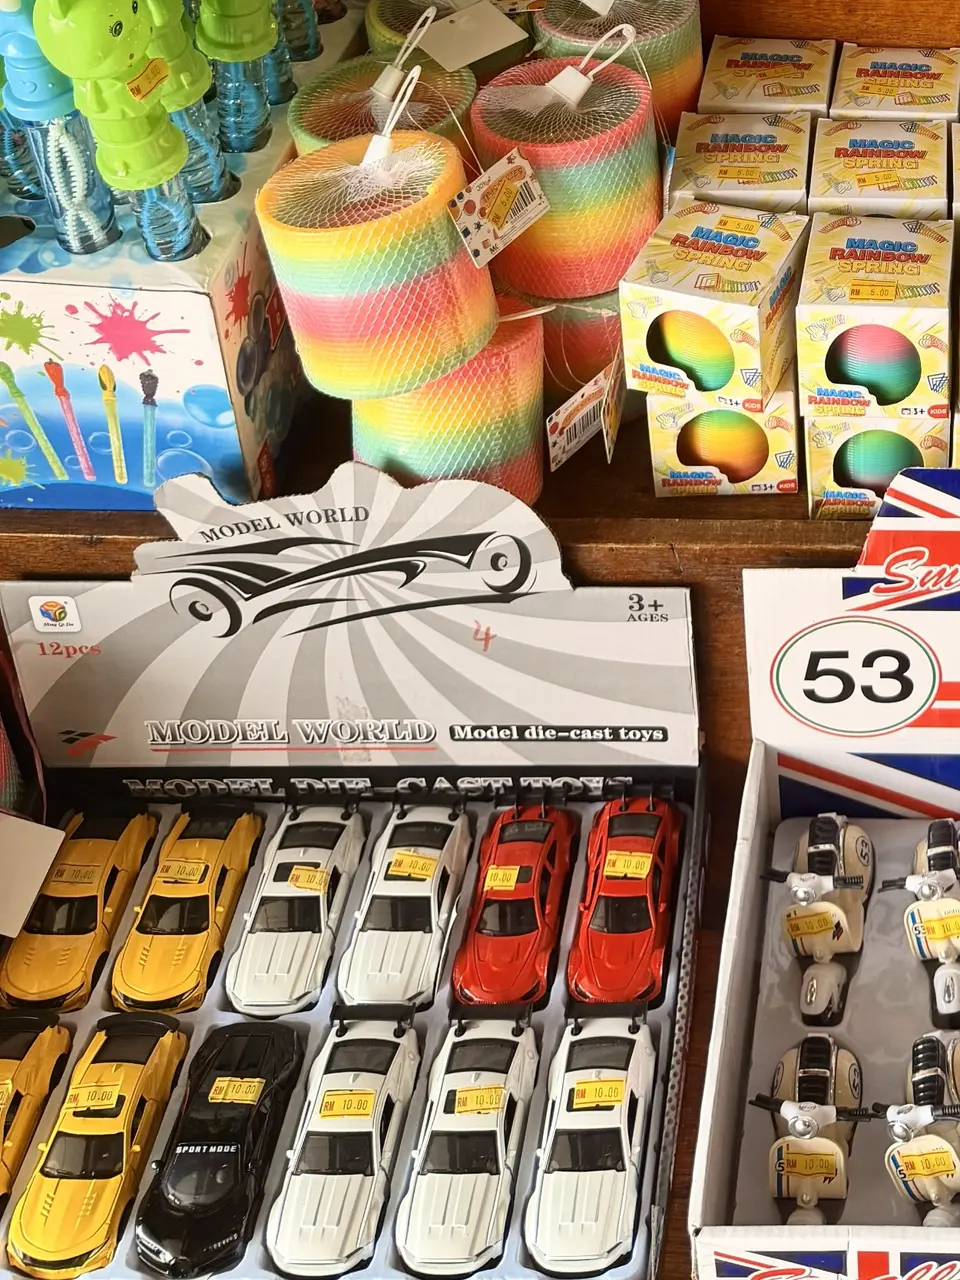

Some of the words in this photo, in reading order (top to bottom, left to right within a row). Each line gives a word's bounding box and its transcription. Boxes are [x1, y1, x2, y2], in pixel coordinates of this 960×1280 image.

[741, 52, 802, 62] MAGIC
[870, 61, 932, 72] MAGIC
[855, 68, 944, 80] RAINBOW
[877, 87, 894, 95] 5.00
[710, 133, 777, 144] MAGIC
[849, 139, 915, 150] MAGIC
[695, 142, 789, 154] RAINBOW
[834, 147, 928, 160] RAINBOW
[703, 153, 780, 164] SPRING
[842, 158, 919, 170] SPRING
[737, 169, 755, 177] 5.00
[875, 173, 893, 182] 5.00
[501, 187, 513, 207] 6.00
[736, 222, 755, 232] 5.00
[691, 226, 761, 249] MAGIC
[670, 233, 767, 262] RAINBOW
[846, 238, 918, 252] MAGIC
[673, 248, 752, 272] SPRING
[829, 247, 932, 263] RAINBOW
[837, 259, 921, 275] SPRING
[850, 288, 861, 297] RM
[870, 287, 890, 297] 5.00
[639, 363, 683, 381] MAGIC
[631, 369, 690, 390] RAINBOW
[638, 380, 686, 397] SPRING
[816, 387, 864, 399] MAGIC
[729, 399, 741, 407] 3+
[745, 401, 761, 410] KIDS
[808, 395, 871, 407] RAINBOW
[815, 405, 866, 416] SPRING
[913, 407, 926, 416] 3+
[930, 408, 947, 416] KIDS
[669, 471, 715, 479] MAGIC
[661, 477, 722, 487] RAINBOW
[763, 483, 774, 491] 3+
[668, 486, 718, 495] SPRING
[823, 490, 869, 500] MAGIC
[816, 498, 876, 508] RAINBOW
[820, 506, 870, 516] SPRING
[199, 513, 281, 544] MODEL
[284, 505, 371, 529] WORLD
[628, 594, 664, 612] 3+
[626, 613, 669, 622] AGES
[472, 620, 498, 652] 4
[36, 640, 102, 658] 12pcs
[800, 649, 916, 704] 53
[145, 719, 290, 744] MODEL
[292, 719, 437, 744] WORLD
[453, 724, 519, 740] Model
[524, 724, 613, 740] die-cast
[620, 726, 664, 742] toys
[123, 778, 286, 798] MODEL
[859, 838, 870, 863] 53
[161, 865, 172, 876] RM
[177, 865, 201, 878] 10.00
[391, 858, 404, 870] RM
[409, 859, 433, 873] 10.00
[606, 858, 617, 870] RM
[622, 859, 647, 872] 10.00
[54, 867, 67, 879] RM
[71, 869, 95, 880] 10.00
[289, 872, 301, 885] RM
[489, 871, 512, 883] 10.00
[790, 922, 800, 932] RM
[806, 919, 829, 930] 10.00
[927, 926, 936, 936] RM
[214, 1084, 225, 1096] RM
[231, 1083, 257, 1096] 10.00
[575, 1088, 587, 1100] RM
[594, 1086, 619, 1099] 10.00
[67, 1092, 80, 1104] RM
[86, 1090, 113, 1102] 10.00
[457, 1097, 468, 1108] RM
[475, 1095, 500, 1109] 10.00
[324, 1101, 335, 1112] RM
[342, 1099, 369, 1111] 10.00
[176, 1145, 208, 1155] SPORT
[209, 1144, 238, 1154] MODE
[787, 1160, 797, 1169] RM
[804, 1159, 830, 1170] 10.00
[906, 1162, 915, 1171] RM
[920, 1158, 946, 1170] 10.00
